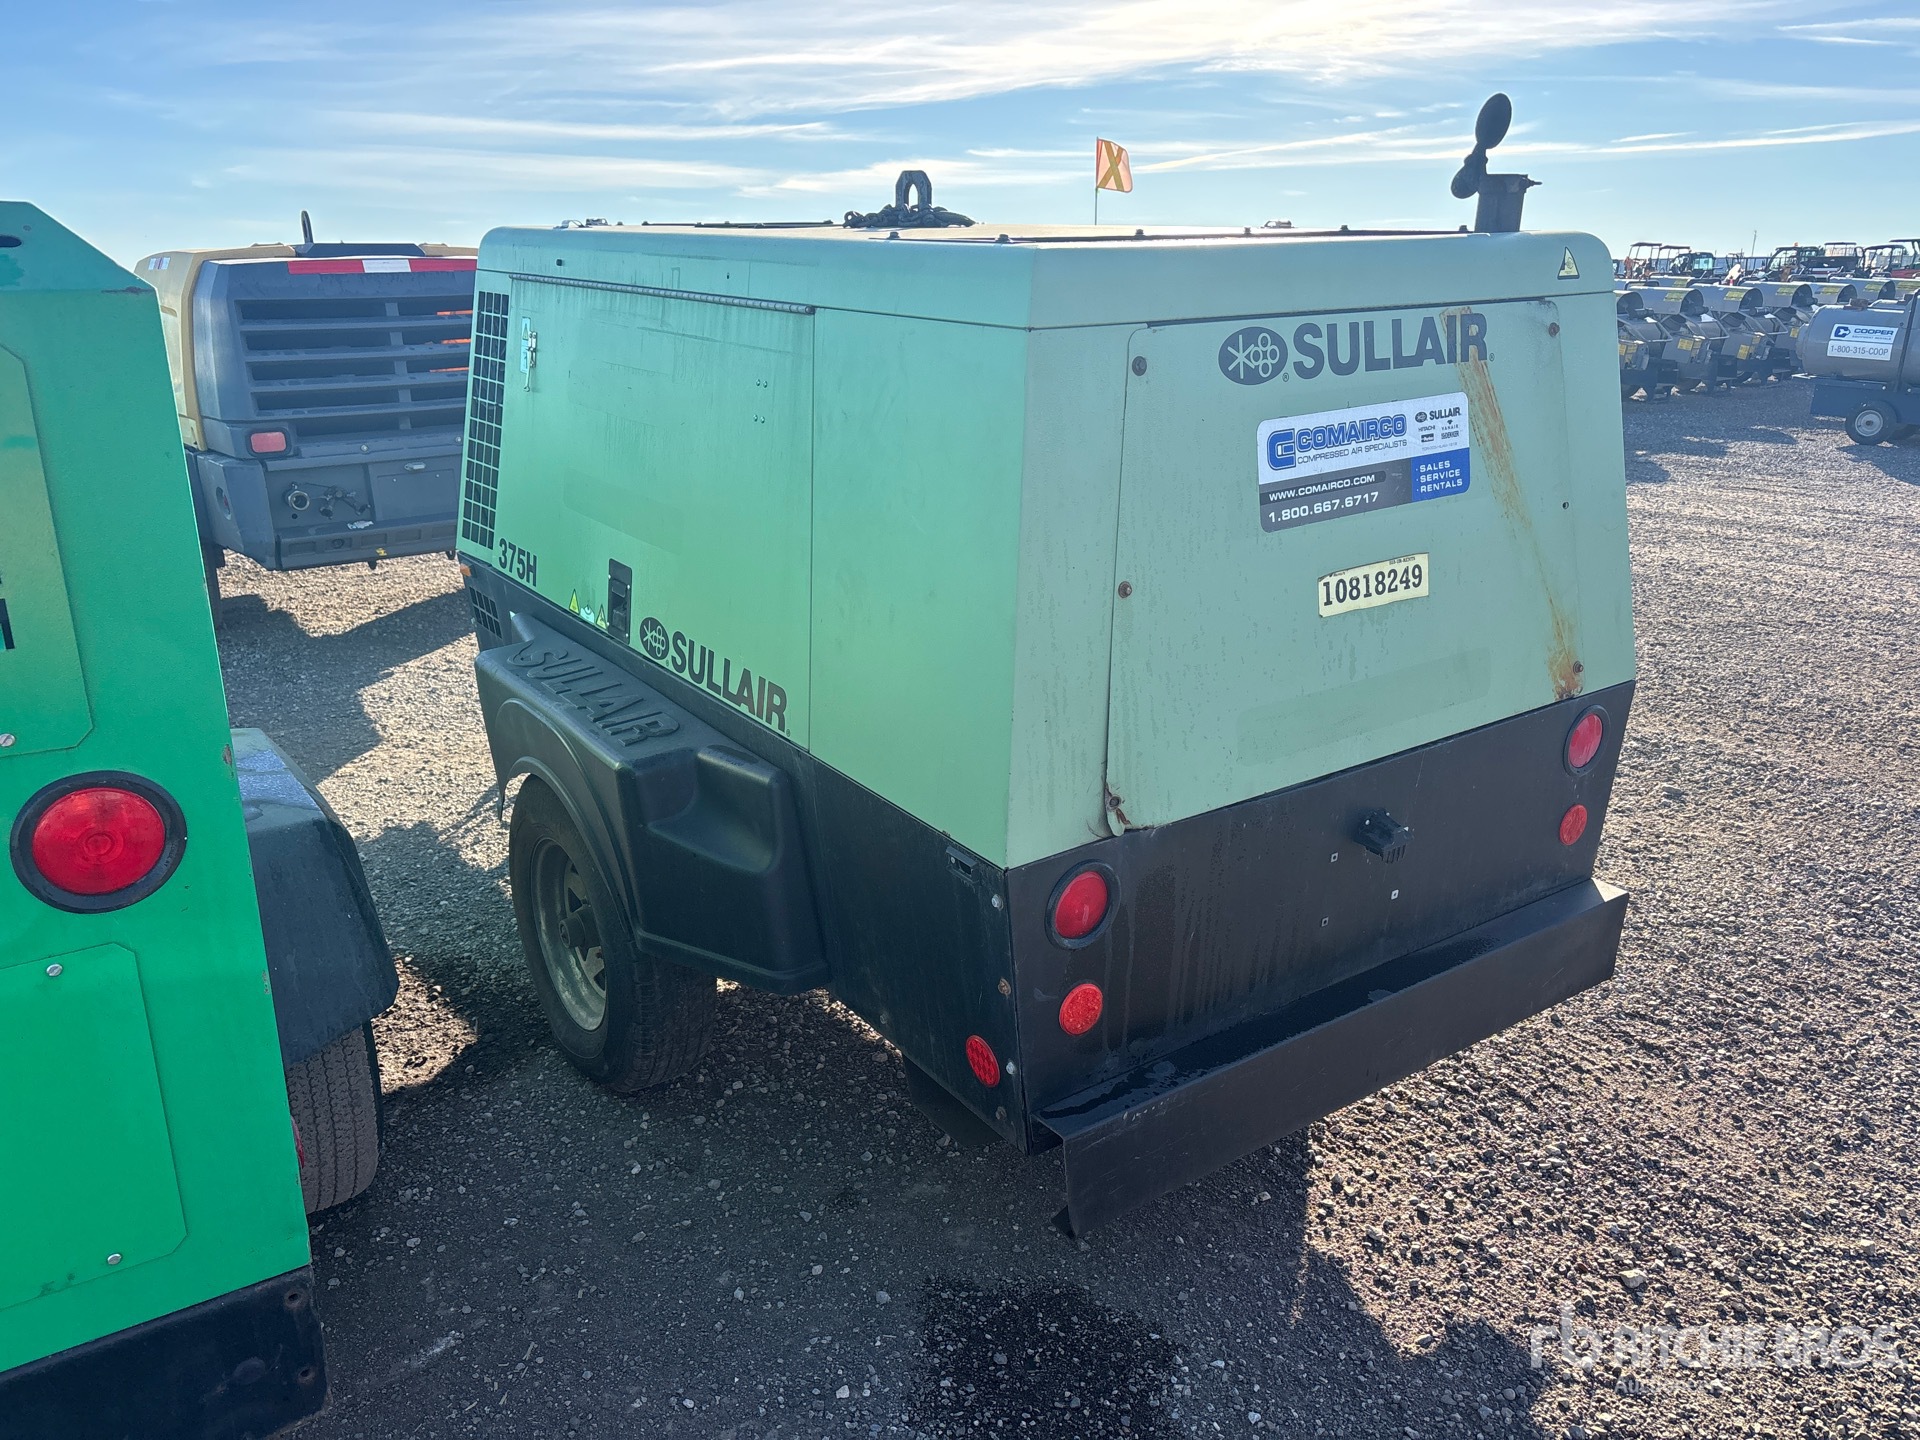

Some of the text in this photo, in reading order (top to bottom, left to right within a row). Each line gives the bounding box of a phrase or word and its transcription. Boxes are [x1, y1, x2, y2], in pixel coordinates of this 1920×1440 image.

[1854, 328, 1894, 336] COOPER
[1292, 312, 1488, 380] SULLAIR
[1831, 345, 1889, 356] 1-800-315-COOP
[1429, 407, 1460, 420] SULLAIR
[1296, 413, 1407, 452] COMAIRCO
[1297, 449, 1350, 465] COMPRESSED
[1351, 446, 1363, 455] AIR
[1364, 439, 1408, 453] SPECIALISTS
[1419, 460, 1451, 473] SALES
[1420, 469, 1461, 483] SERVICE
[1269, 475, 1375, 502] WWW.COMAIRCO.COM
[1420, 479, 1463, 493] RENTALS
[1268, 491, 1379, 523] 1.800.667.6717
[498, 537, 538, 587] 375H
[1323, 563, 1423, 606] 10818249
[507, 642, 681, 748] SULLAIR
[671, 630, 788, 733] SULLAIR
